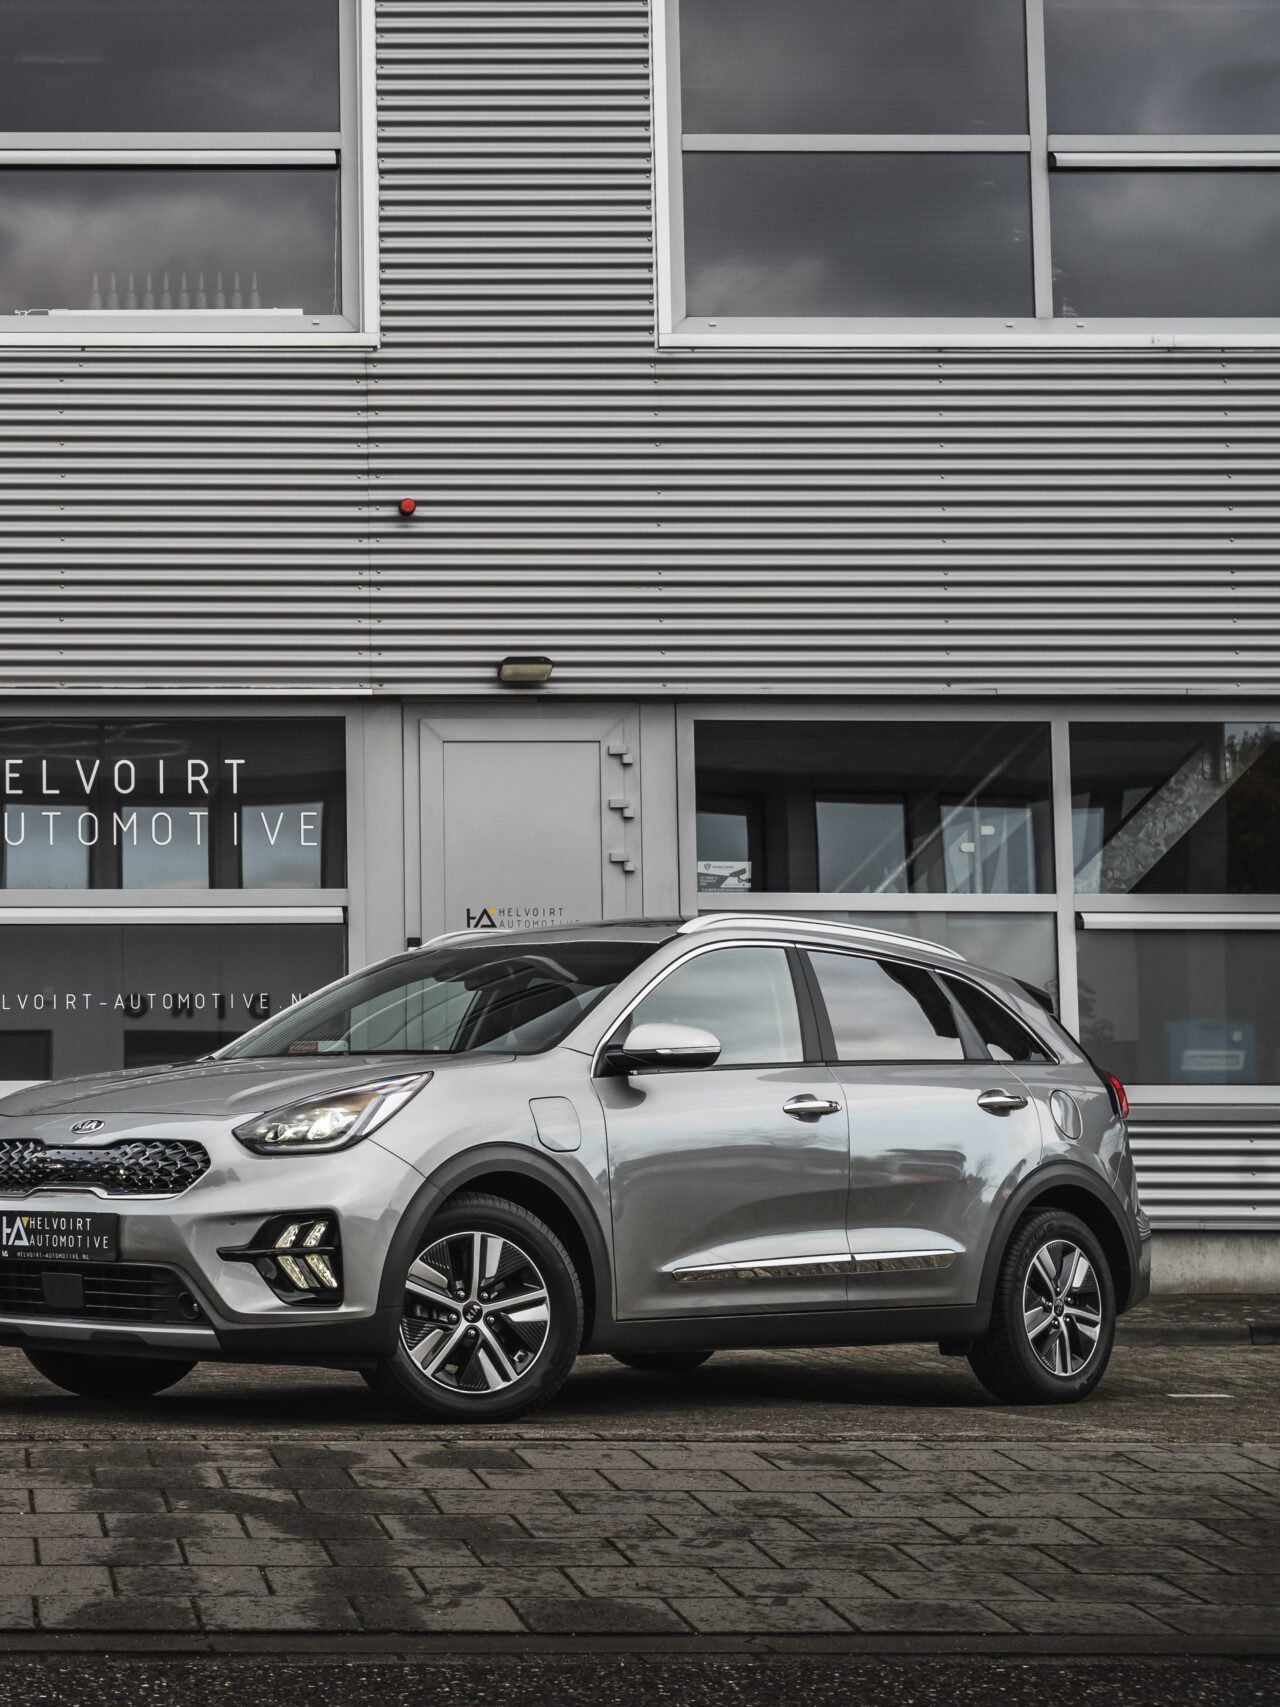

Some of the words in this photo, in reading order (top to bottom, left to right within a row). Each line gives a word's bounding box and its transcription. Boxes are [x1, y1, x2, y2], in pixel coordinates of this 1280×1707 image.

[499, 908, 564, 917] HELVOIRT
[29, 1217, 92, 1231] HELVOIRT
[29, 1234, 109, 1249] AUTOMOTIVE
[465, 1304, 481, 1321] KIA
